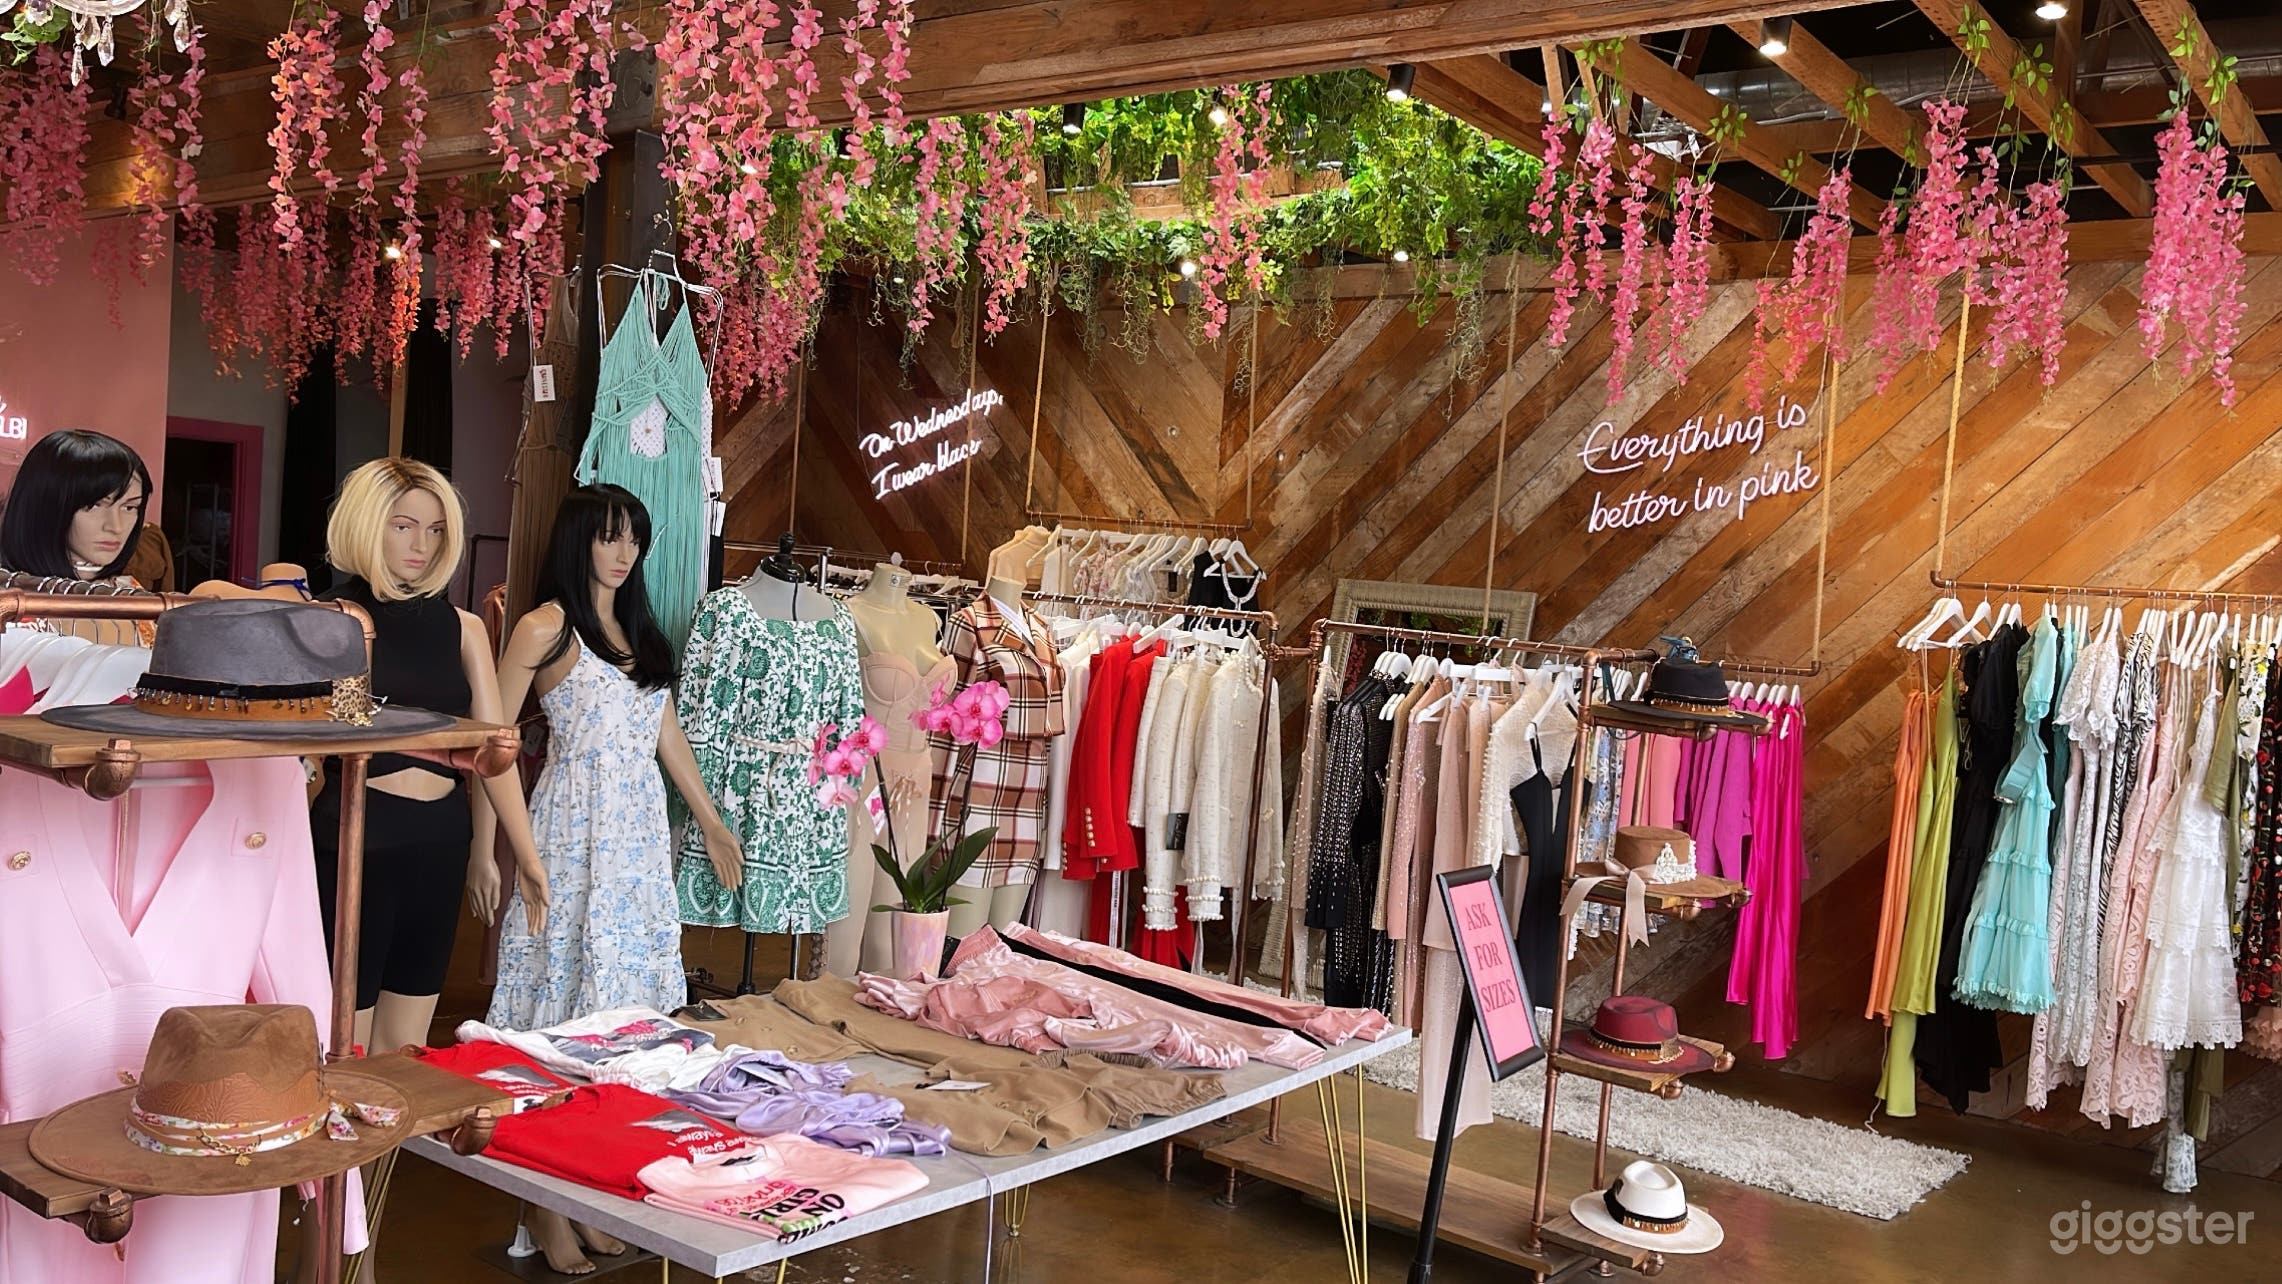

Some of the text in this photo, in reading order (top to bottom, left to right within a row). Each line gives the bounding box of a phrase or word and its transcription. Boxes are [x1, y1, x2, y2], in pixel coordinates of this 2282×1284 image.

[859, 388, 1003, 458] On Wednesdays,
[1577, 395, 1806, 473] Everything is
[871, 462, 899, 500] I
[892, 462, 936, 491] wear
[1588, 451, 1819, 533] better in pink
[1465, 902, 1491, 930] ASK
[1473, 942, 1502, 971] FOR
[1481, 979, 1515, 1012] SIZES
